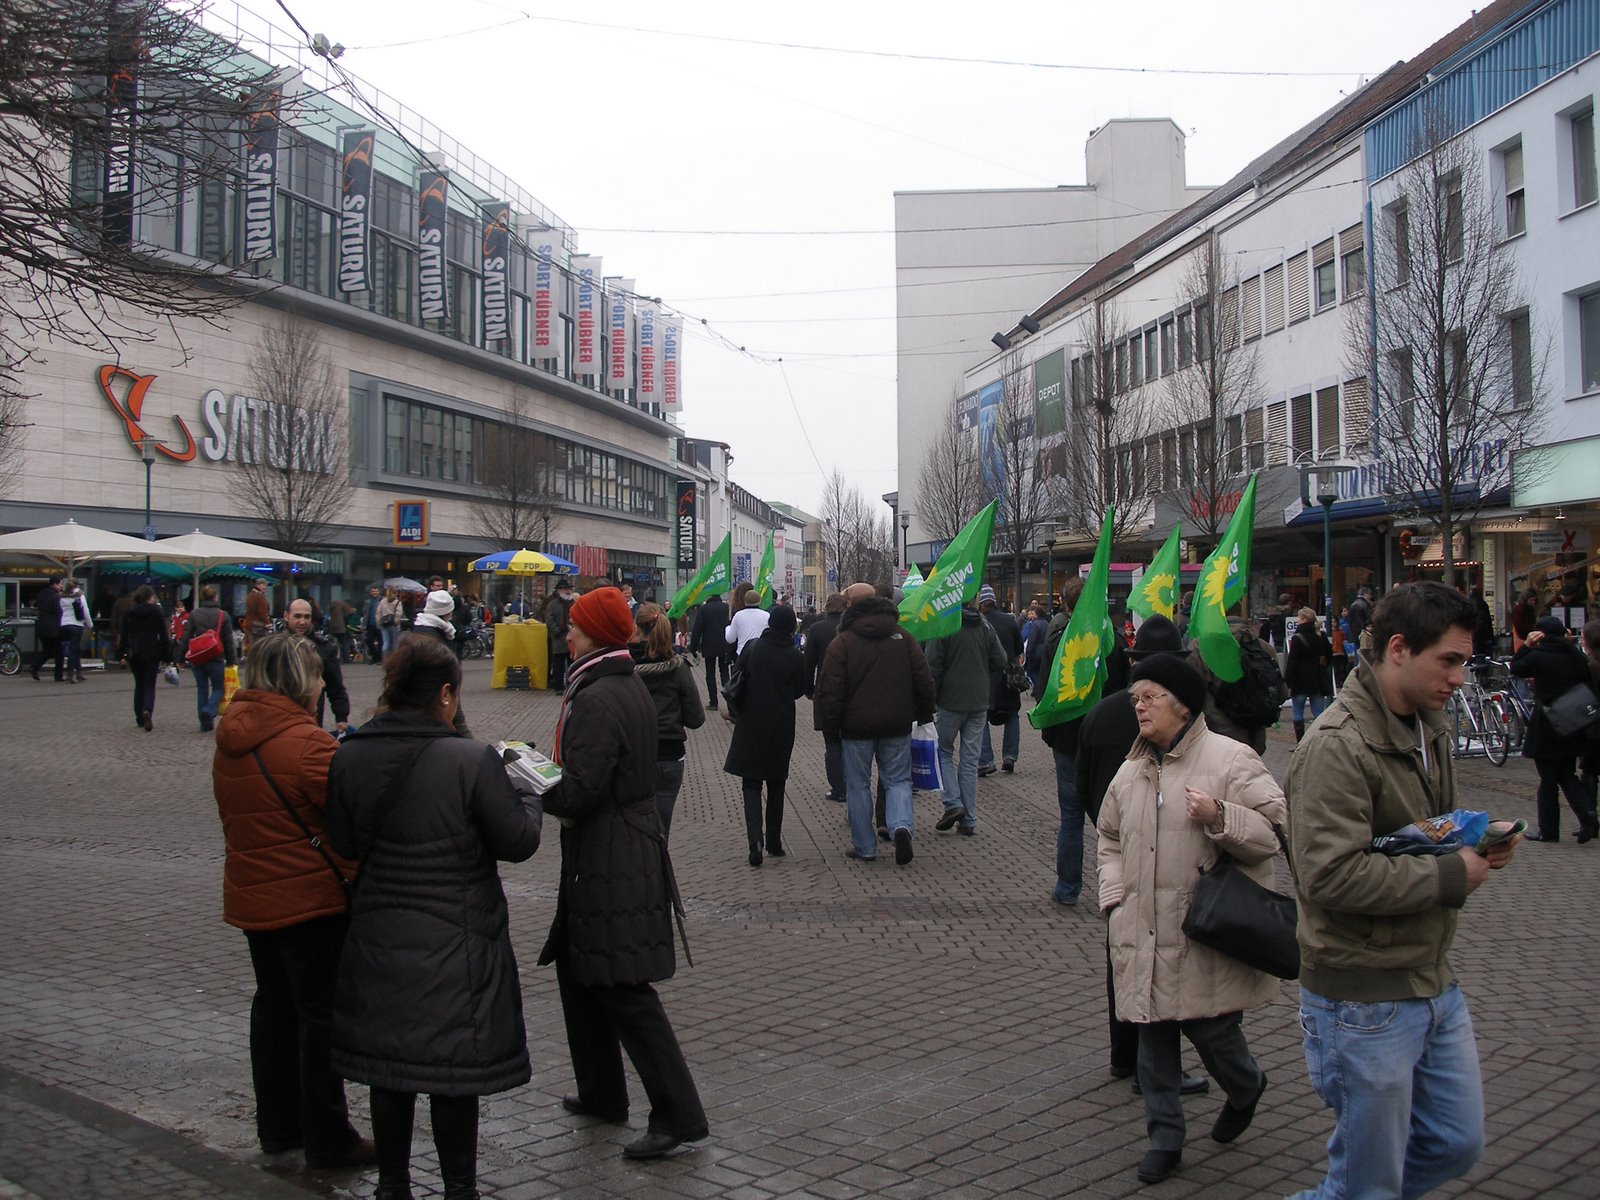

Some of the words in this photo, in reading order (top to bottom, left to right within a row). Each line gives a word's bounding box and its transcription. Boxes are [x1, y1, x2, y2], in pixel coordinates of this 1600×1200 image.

[247, 152, 272, 259] SATURN
[340, 194, 366, 292] SATURN
[536, 244, 553, 289] SPORT
[419, 228, 444, 320] SATURN
[483, 256, 508, 340] SATURN
[578, 268, 593, 311] SPORT
[535, 290, 553, 347] HÜBNER
[578, 311, 595, 364] HÜBNER
[641, 309, 654, 346] SPORT
[612, 329, 627, 379] HÜBNER
[641, 346, 655, 393] HÜBNER
[1038, 382, 1061, 401] DEPOT
[203, 389, 336, 475] SATURN
[401, 528, 421, 536] ALDI
